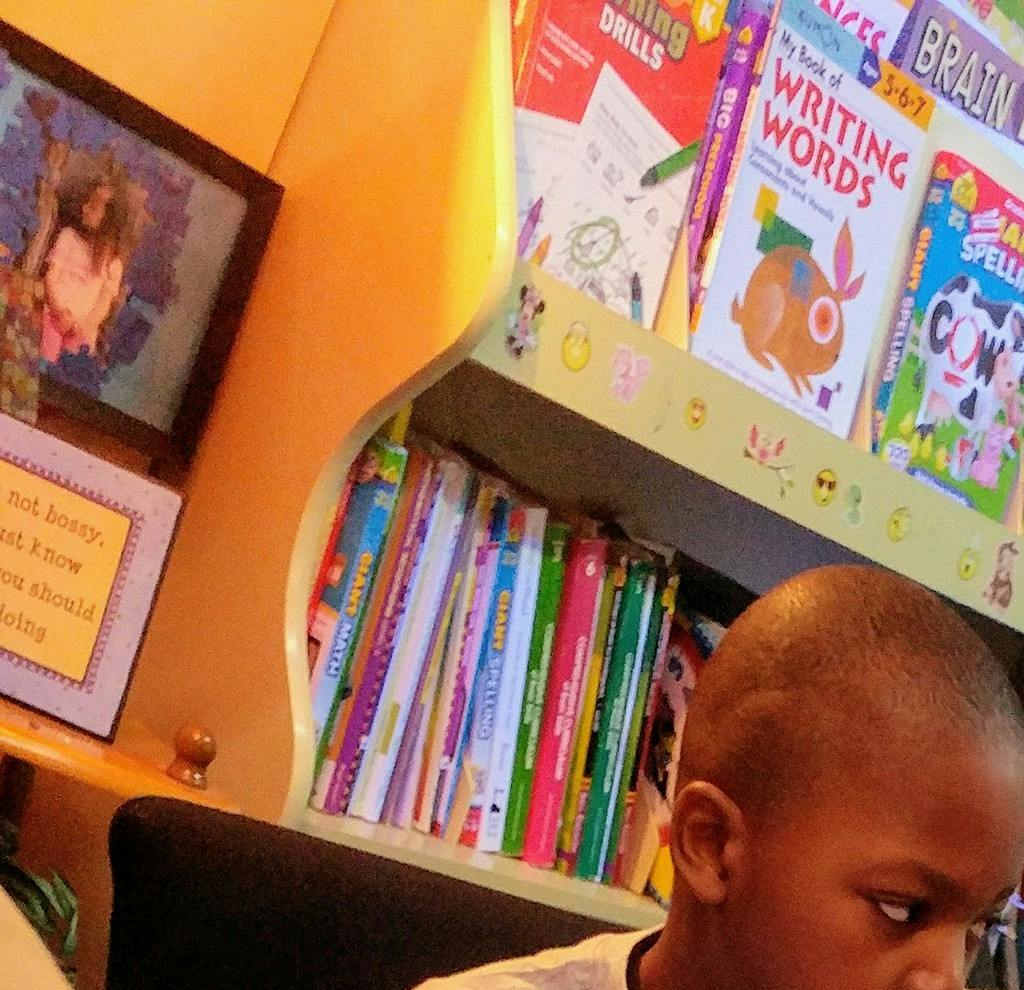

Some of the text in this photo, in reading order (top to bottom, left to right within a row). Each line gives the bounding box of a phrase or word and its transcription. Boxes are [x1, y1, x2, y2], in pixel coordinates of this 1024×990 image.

[599, 3, 665, 71] DRILLS
[780, 29, 797, 59] My
[799, 44, 826, 79] Book
[913, 16, 1018, 131] BRAIN
[763, 100, 876, 209] WORDS
[773, 57, 909, 191] WRITING
[8, 488, 105, 548] not bossy.
[30, 537, 83, 576] know
[28, 578, 98, 624] should
